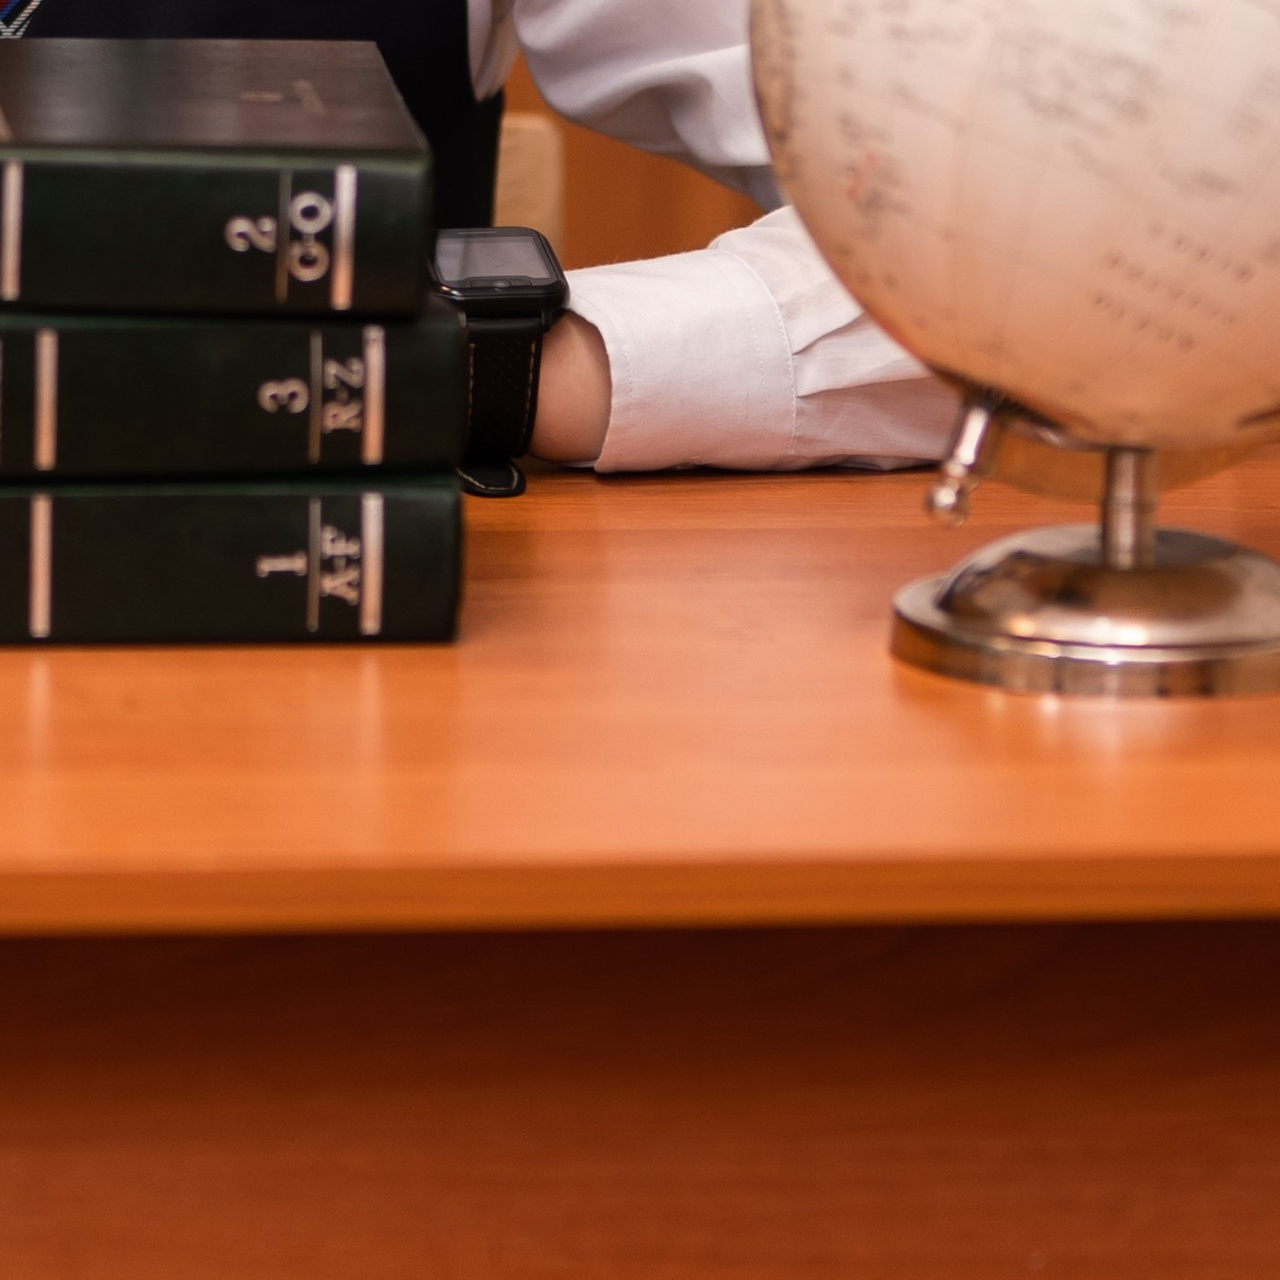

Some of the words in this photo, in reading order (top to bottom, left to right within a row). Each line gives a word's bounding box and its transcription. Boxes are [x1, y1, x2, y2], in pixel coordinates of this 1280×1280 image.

[226, 215, 277, 253] 2
[257, 377, 309, 414] 3
[322, 357, 363, 433] R-Z
[256, 551, 307, 577] 1
[321, 525, 360, 604] A-F
